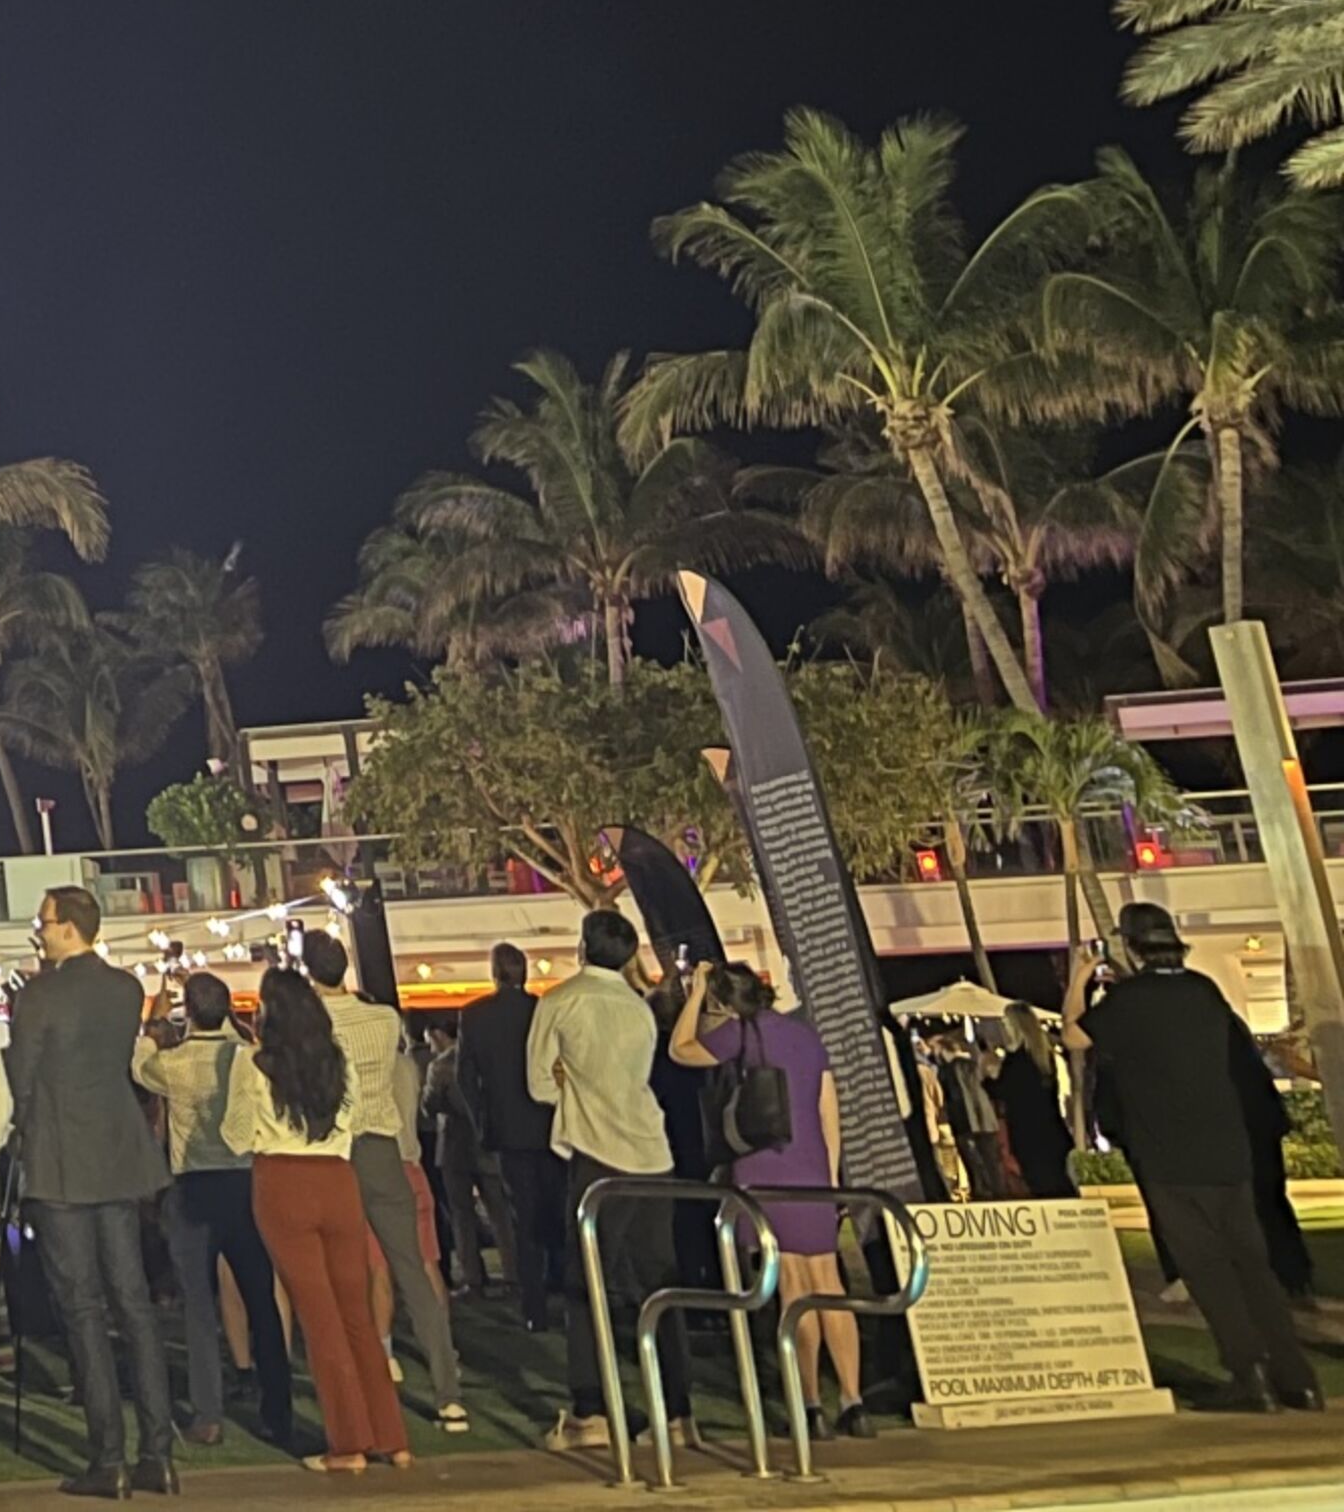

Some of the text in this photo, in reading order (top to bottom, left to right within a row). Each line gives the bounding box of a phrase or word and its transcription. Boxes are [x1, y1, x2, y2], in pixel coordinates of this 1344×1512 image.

[894, 1205, 1036, 1240] O DIVING
[928, 1378, 972, 1398] POOL
[972, 1373, 1047, 1394] MAXIMUM
[1048, 1369, 1093, 1389] DEPTH
